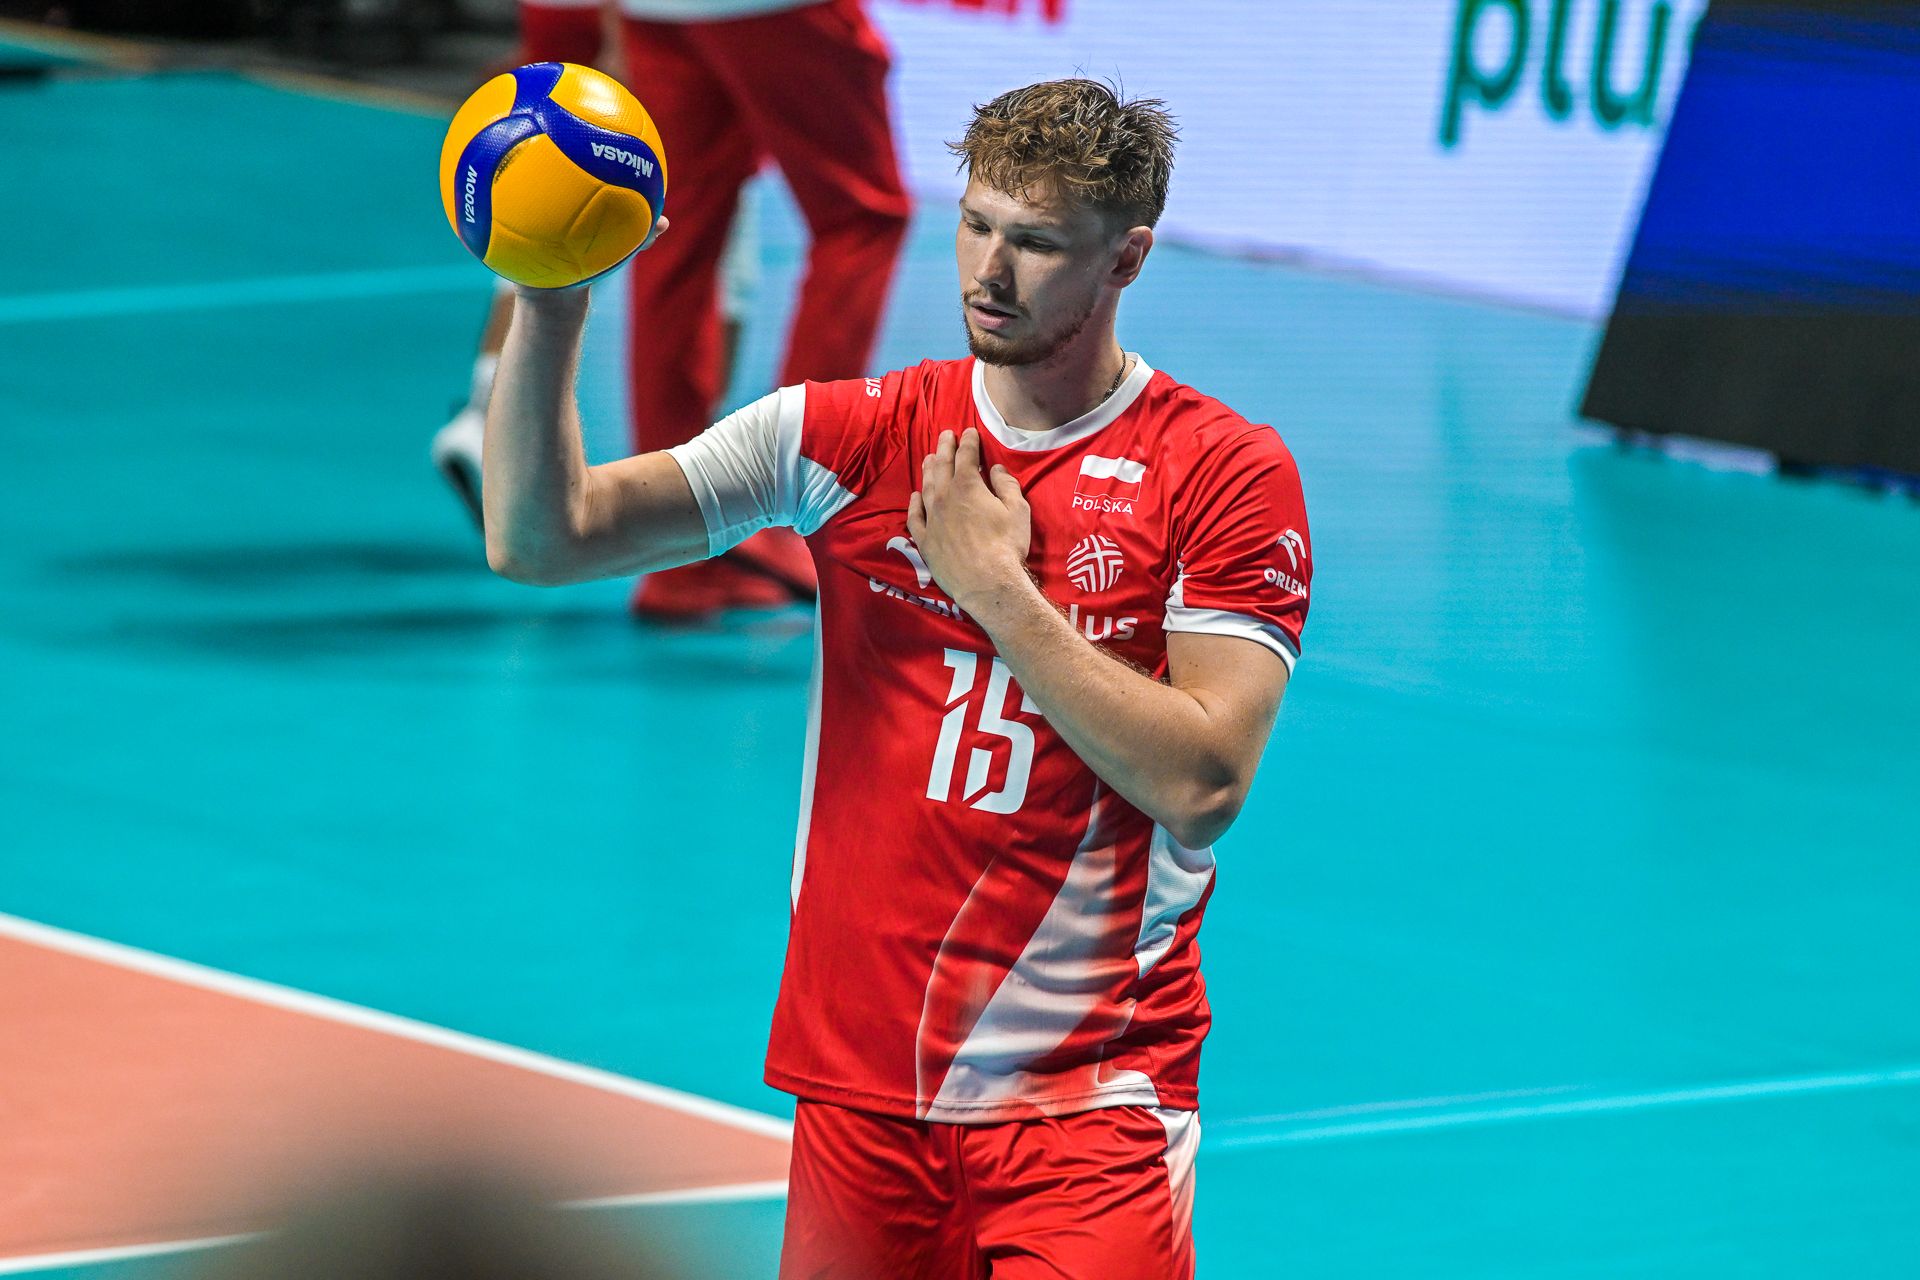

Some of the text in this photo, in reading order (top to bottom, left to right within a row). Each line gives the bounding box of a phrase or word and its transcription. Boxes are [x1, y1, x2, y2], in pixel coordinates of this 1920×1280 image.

[1438, 0, 1702, 150] plu
[465, 164, 479, 224] V200W
[1072, 496, 1133, 515] POLSKA
[1263, 567, 1307, 600] ORLEN
[1069, 604, 1138, 641] lus
[926, 647, 1043, 815] 15
